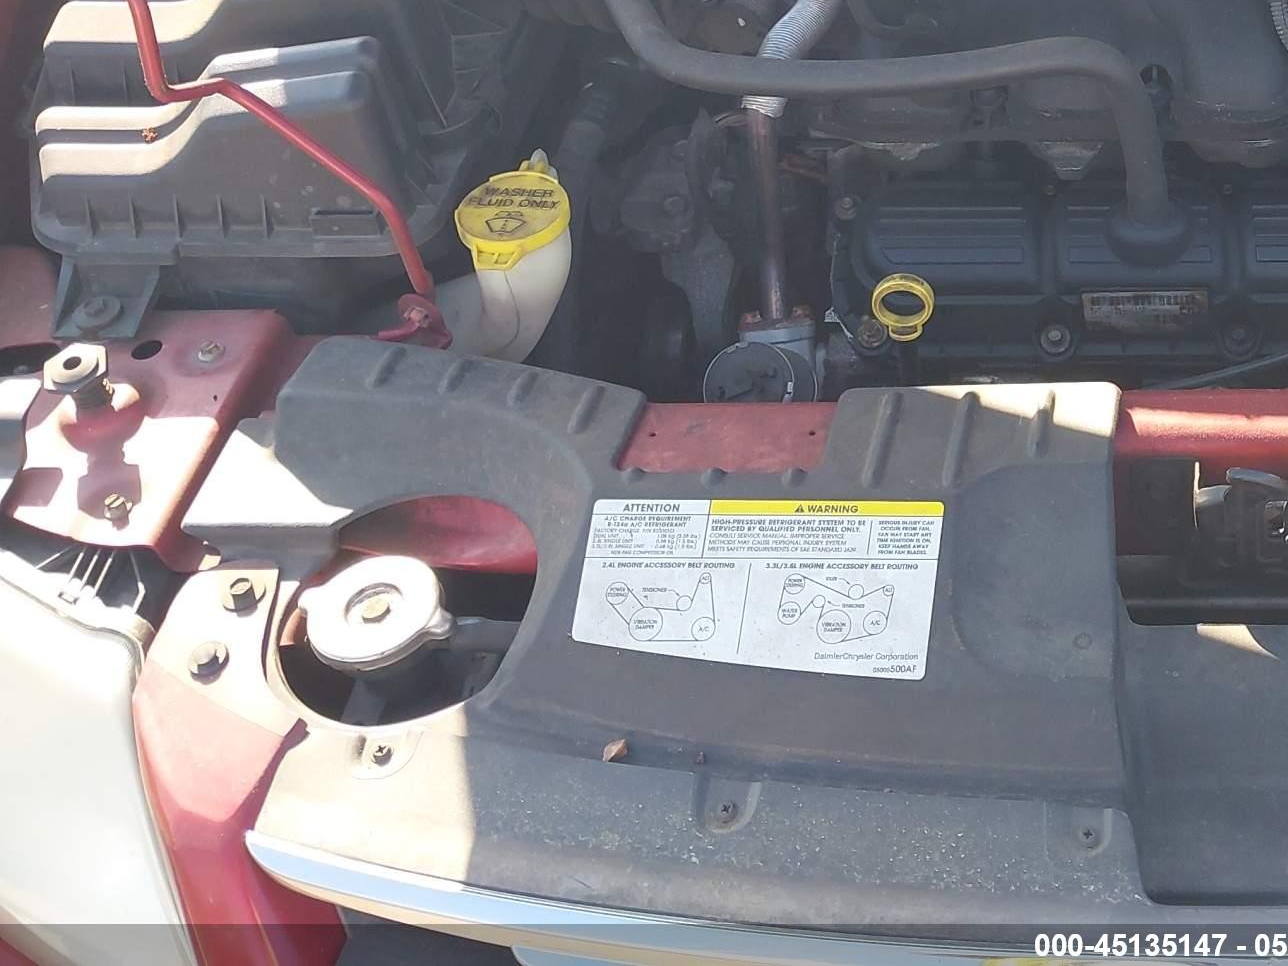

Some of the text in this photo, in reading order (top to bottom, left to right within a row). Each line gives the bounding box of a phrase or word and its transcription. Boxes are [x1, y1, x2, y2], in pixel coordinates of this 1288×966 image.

[485, 186, 554, 197] WASHER
[467, 196, 560, 209] FLUID ONLY
[623, 504, 680, 512] ATTENTION
[808, 505, 859, 514] WARNING
[814, 652, 918, 661] DaimlerChrysler Corporation
